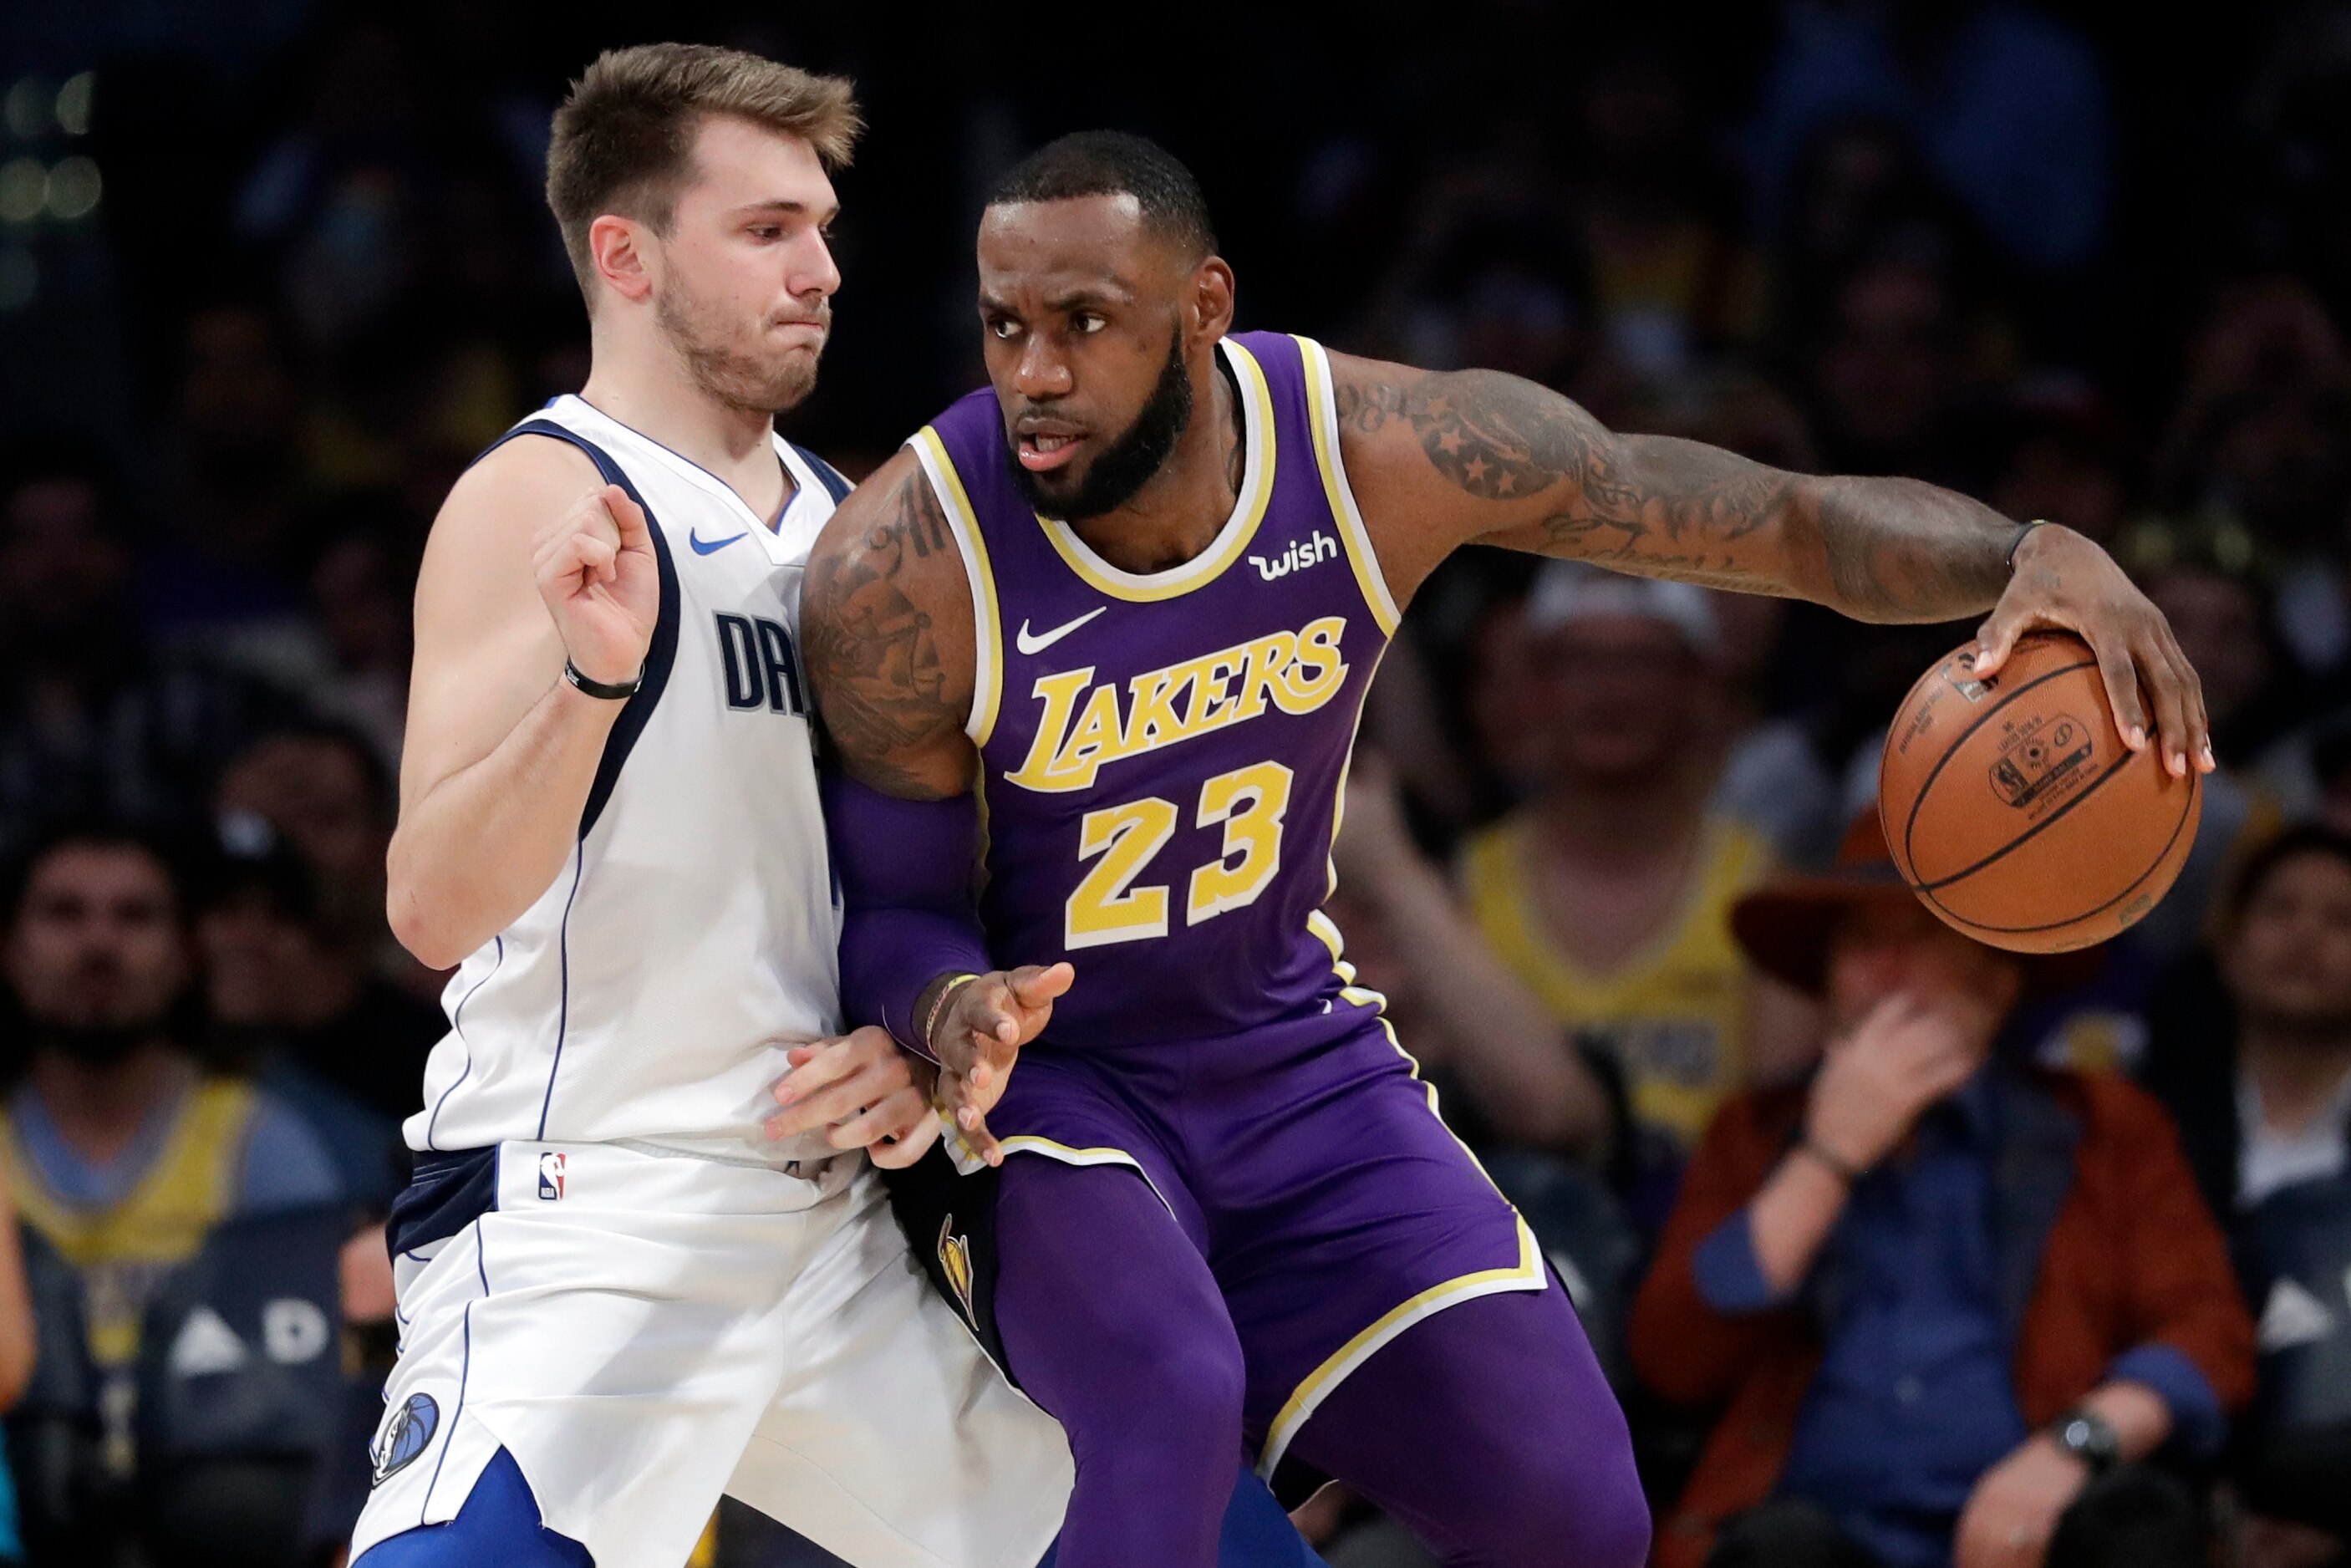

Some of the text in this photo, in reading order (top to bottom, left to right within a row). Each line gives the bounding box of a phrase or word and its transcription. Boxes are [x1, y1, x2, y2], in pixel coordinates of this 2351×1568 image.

[1249, 530, 1337, 581] wish
[1004, 616, 1350, 793] LAKERS
[1064, 759, 1295, 951] 23
